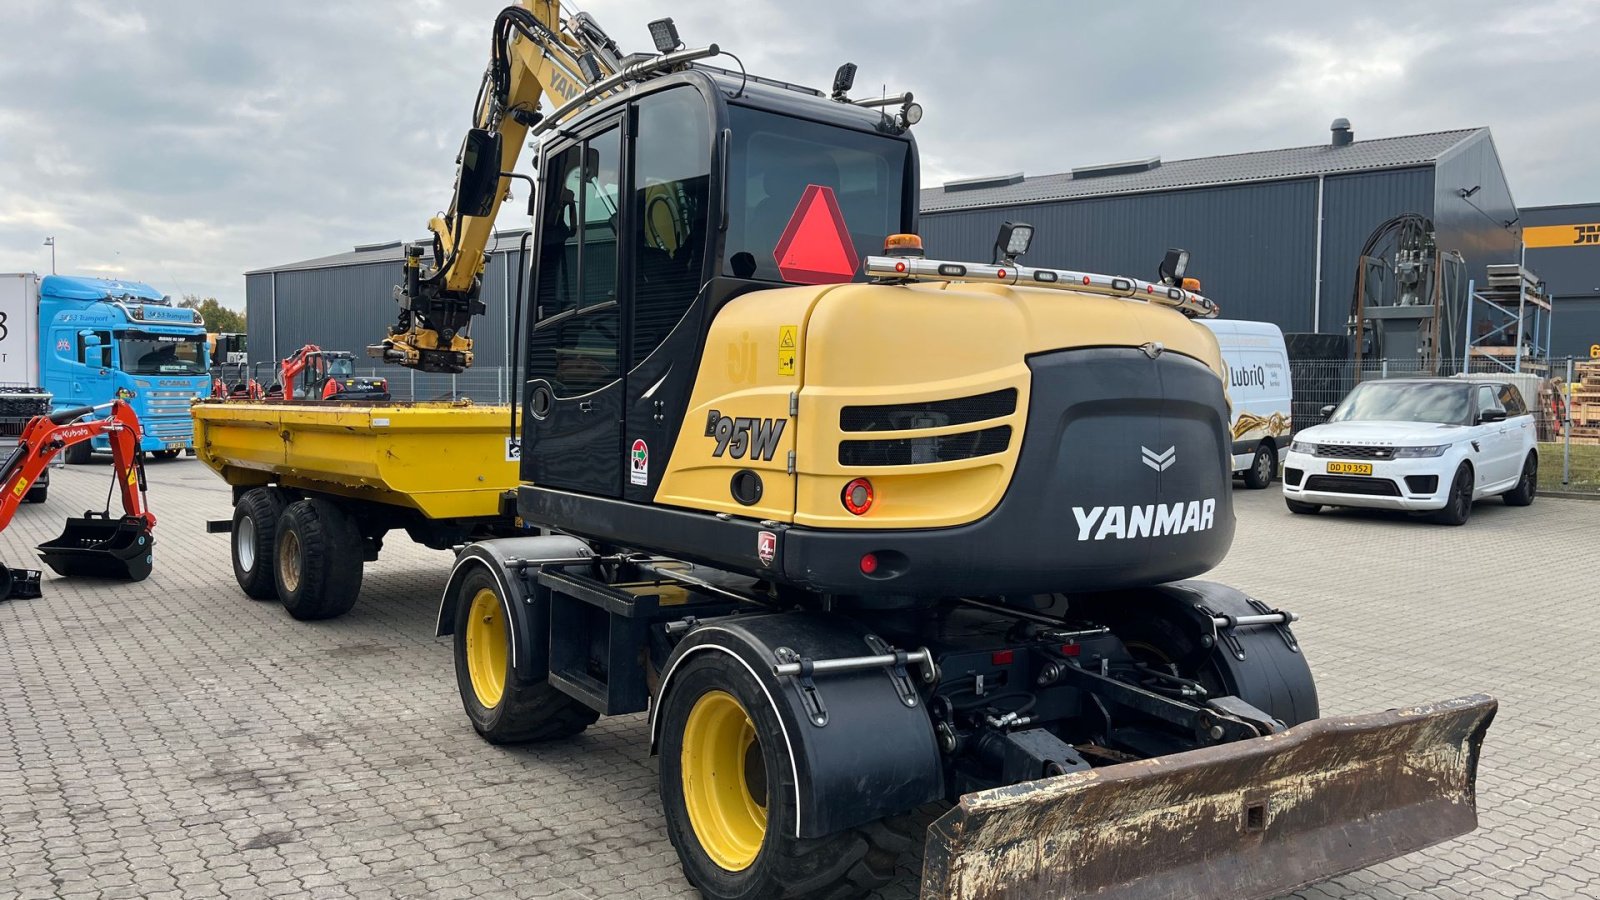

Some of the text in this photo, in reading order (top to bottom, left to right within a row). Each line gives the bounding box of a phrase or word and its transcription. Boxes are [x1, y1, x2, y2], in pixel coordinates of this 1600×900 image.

[79, 314, 108, 323] Transport
[1230, 364, 1265, 390] LubriQ
[62, 429, 89, 438] Kubota
[1330, 463, 1368, 473] DD 19 352
[1071, 498, 1216, 541] YANMAR
